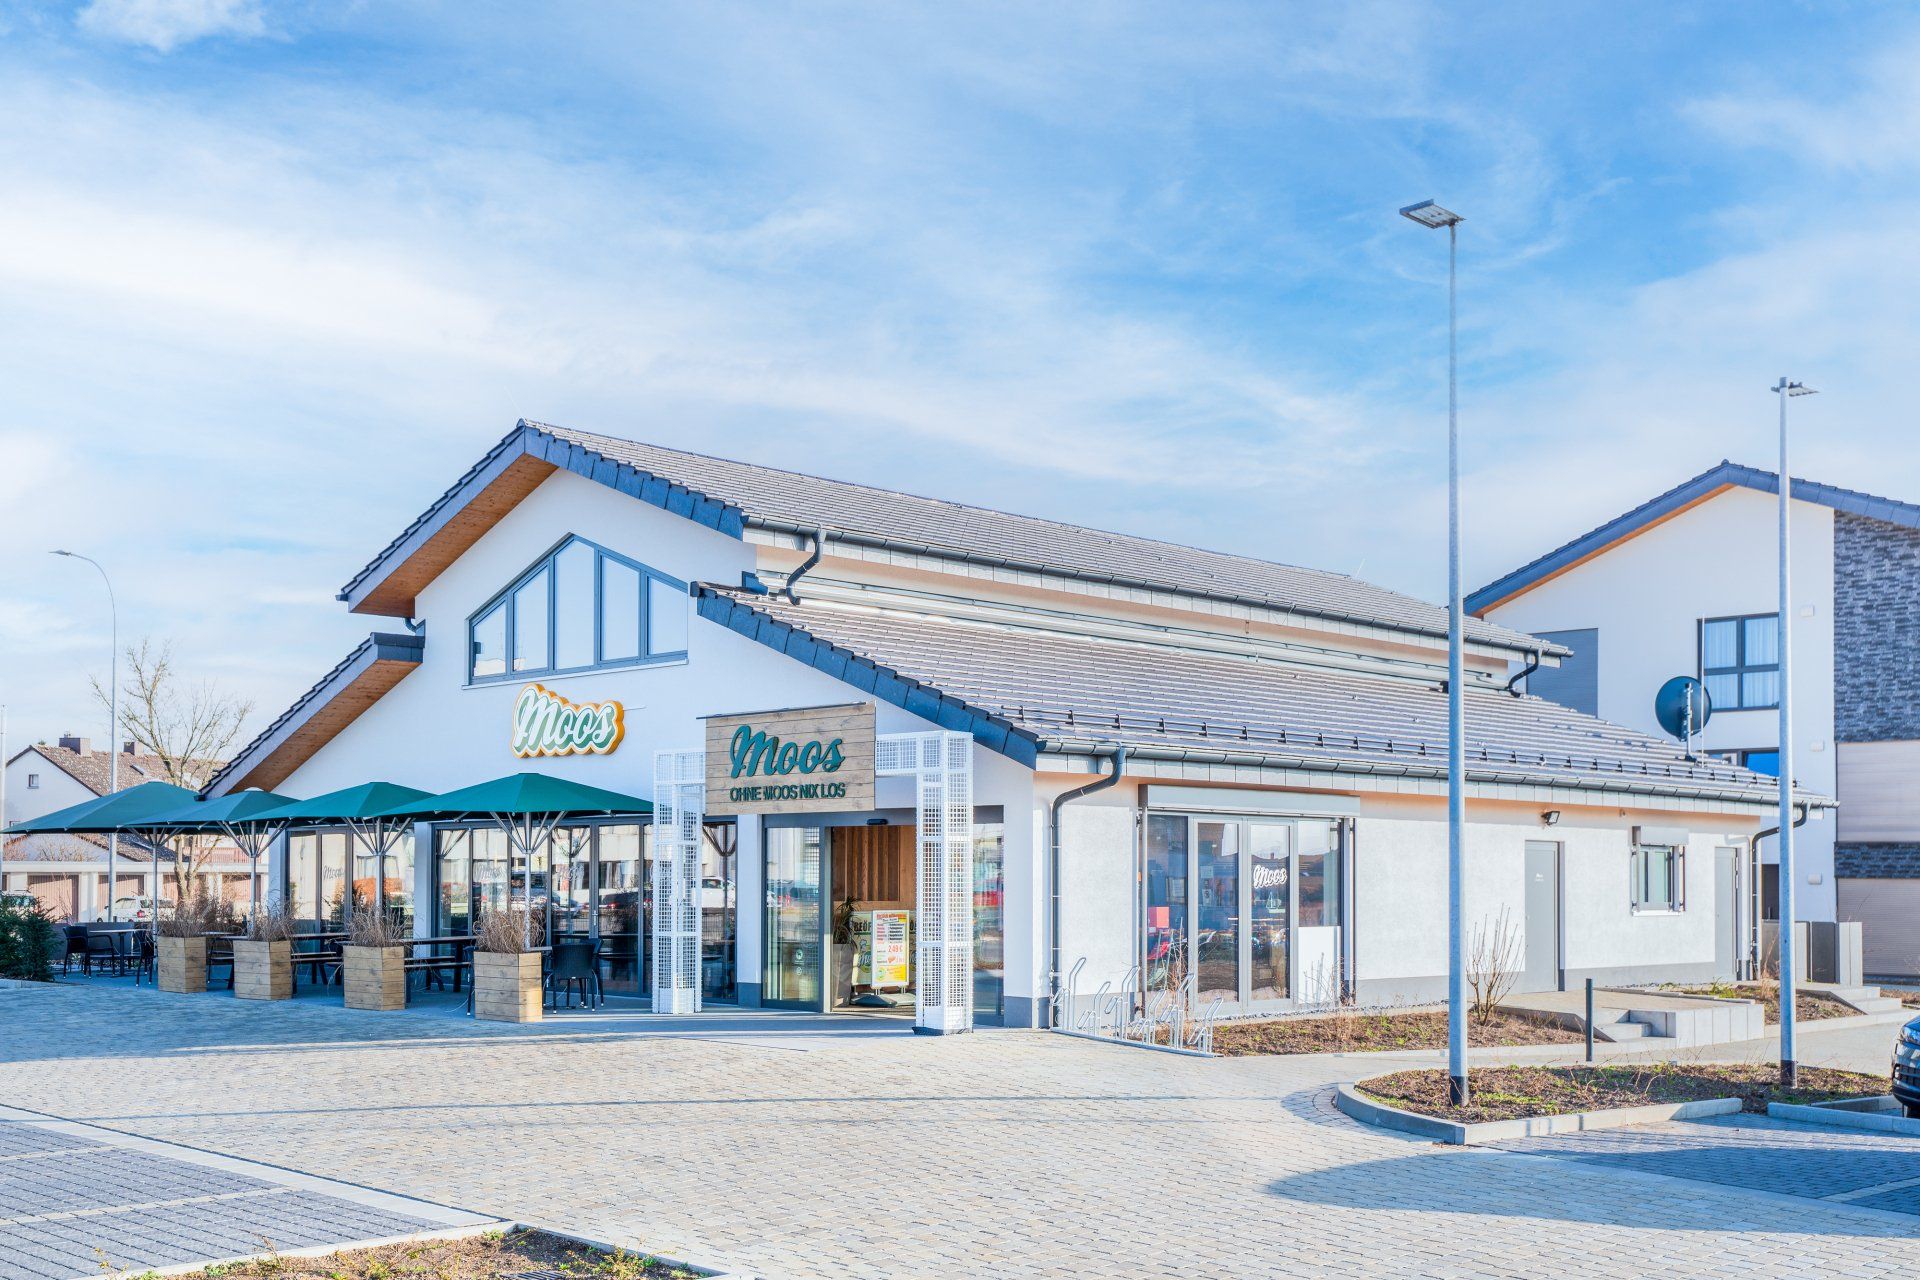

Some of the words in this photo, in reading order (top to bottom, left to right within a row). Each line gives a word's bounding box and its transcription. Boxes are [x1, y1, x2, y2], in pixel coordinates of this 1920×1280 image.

[512, 685, 617, 754] Moos
[729, 724, 846, 779] Moos
[729, 786, 762, 802] OHNE
[763, 784, 798, 801] MOOS
[799, 783, 820, 799] NIX
[820, 781, 846, 798] LOS
[1253, 864, 1287, 889] Moos
